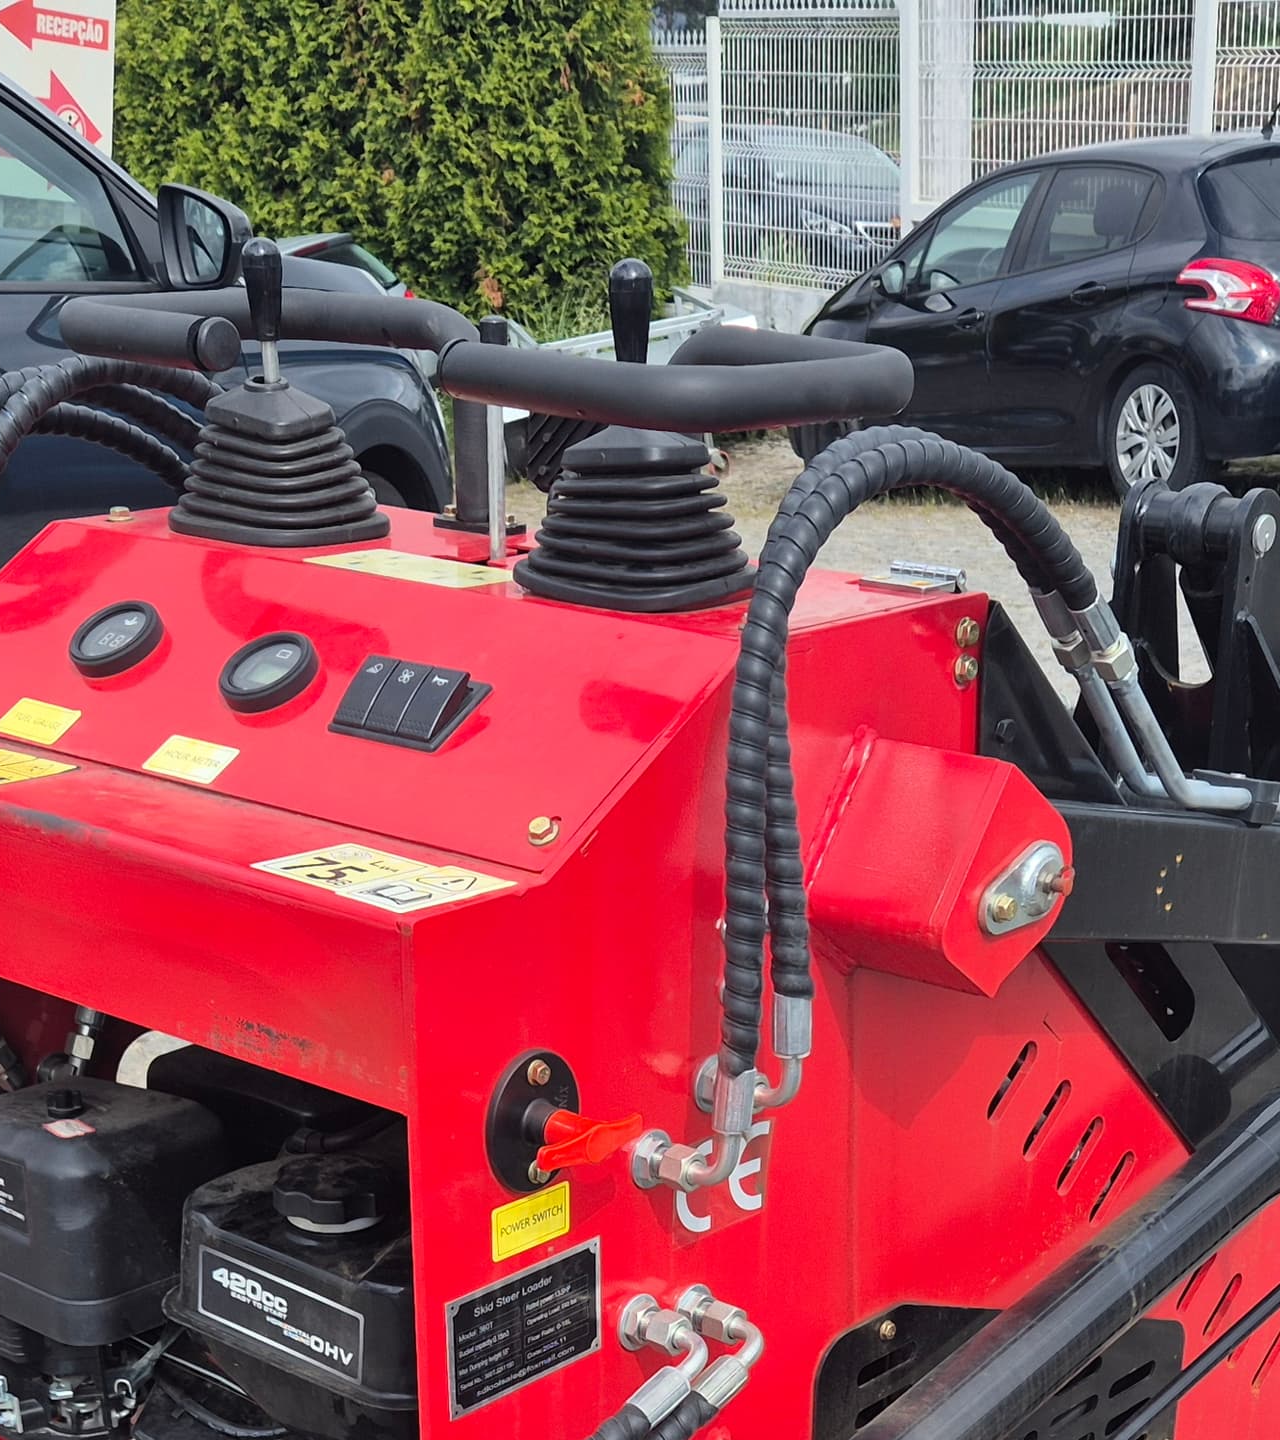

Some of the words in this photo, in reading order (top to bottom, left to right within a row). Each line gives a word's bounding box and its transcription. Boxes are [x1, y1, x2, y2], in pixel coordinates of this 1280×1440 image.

[36, 13, 103, 45] RECEPÇÃO
[281, 856, 368, 880] 75
[676, 1120, 771, 1233] CE
[500, 1217, 531, 1238] POWER
[532, 1203, 563, 1225] SWITCH
[211, 1267, 288, 1314] 420cc
[230, 1291, 251, 1305] EASY
[252, 1301, 263, 1310] TO
[263, 1305, 288, 1320] START
[473, 1301, 493, 1318] Skid
[495, 1290, 519, 1308] Steer
[521, 1275, 552, 1296] Loader
[309, 1335, 353, 1366] OHV
